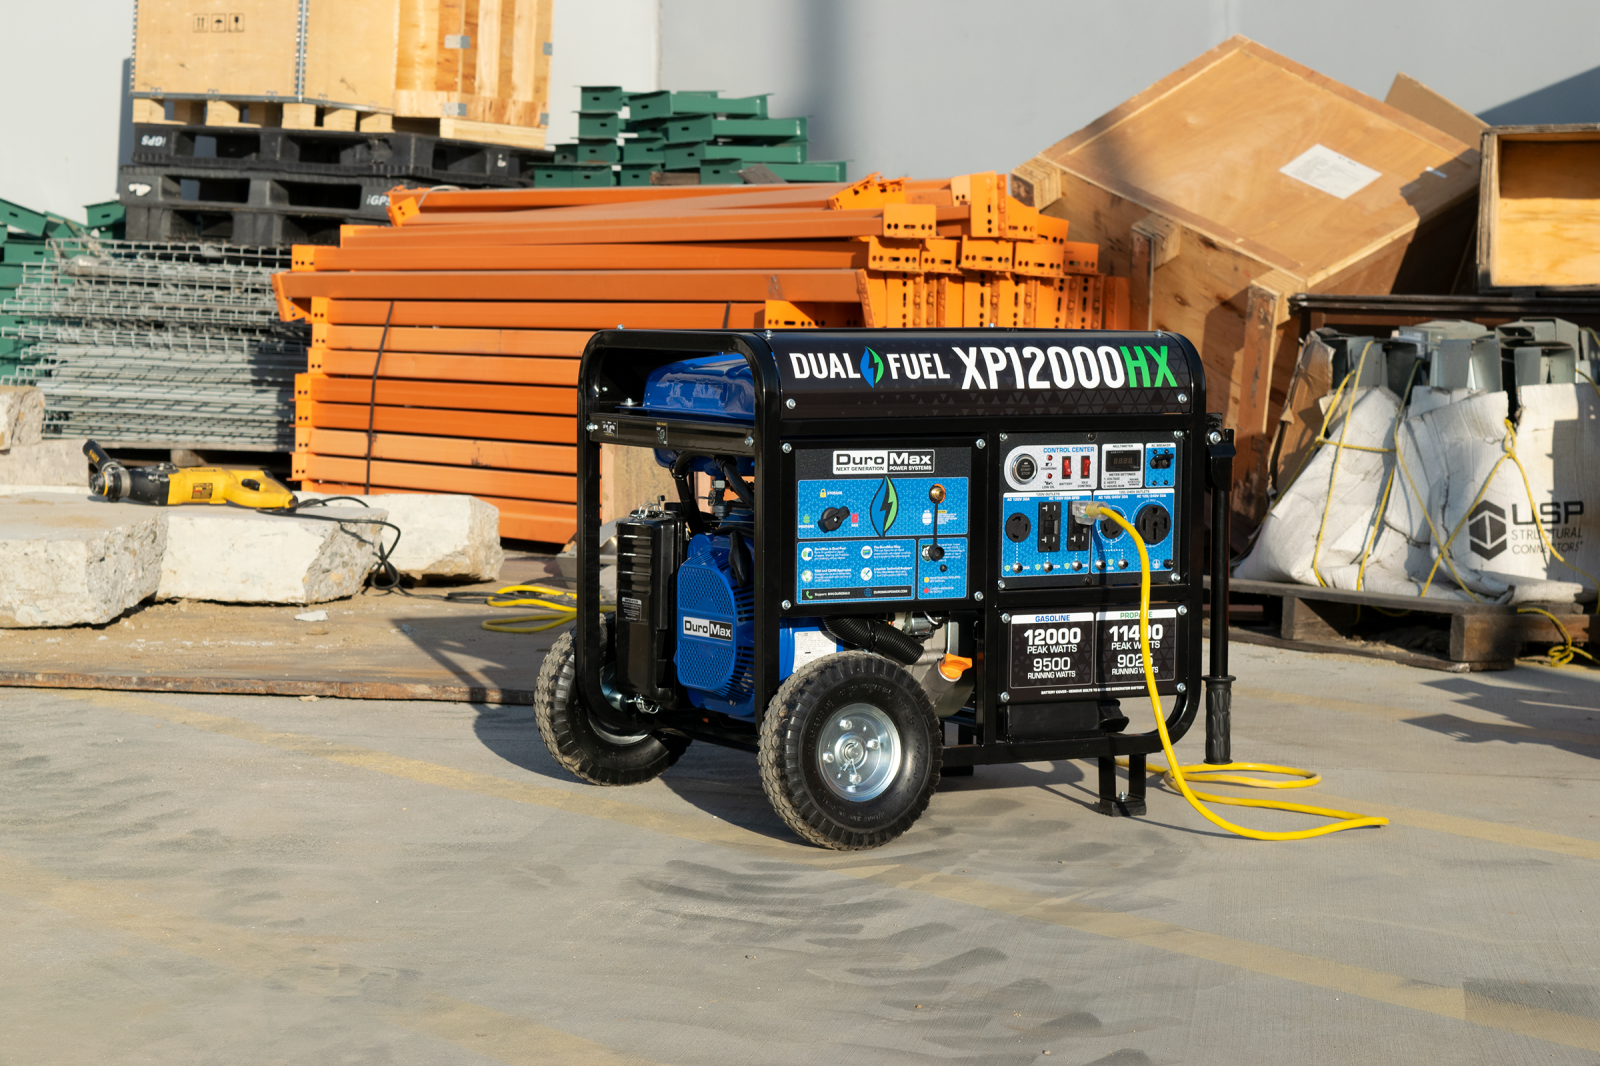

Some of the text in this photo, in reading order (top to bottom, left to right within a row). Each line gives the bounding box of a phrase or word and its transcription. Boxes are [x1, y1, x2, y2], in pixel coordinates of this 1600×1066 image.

[789, 346, 1178, 390] DUAL FUEL XP12000HX
[1512, 501, 1584, 525] USP
[1024, 627, 1081, 645] 12000
[1109, 624, 1163, 641] 1140
[1050, 645, 1077, 653] WATTS
[1112, 641, 1160, 650] PEAK WTS
[1033, 657, 1070, 671] 9500
